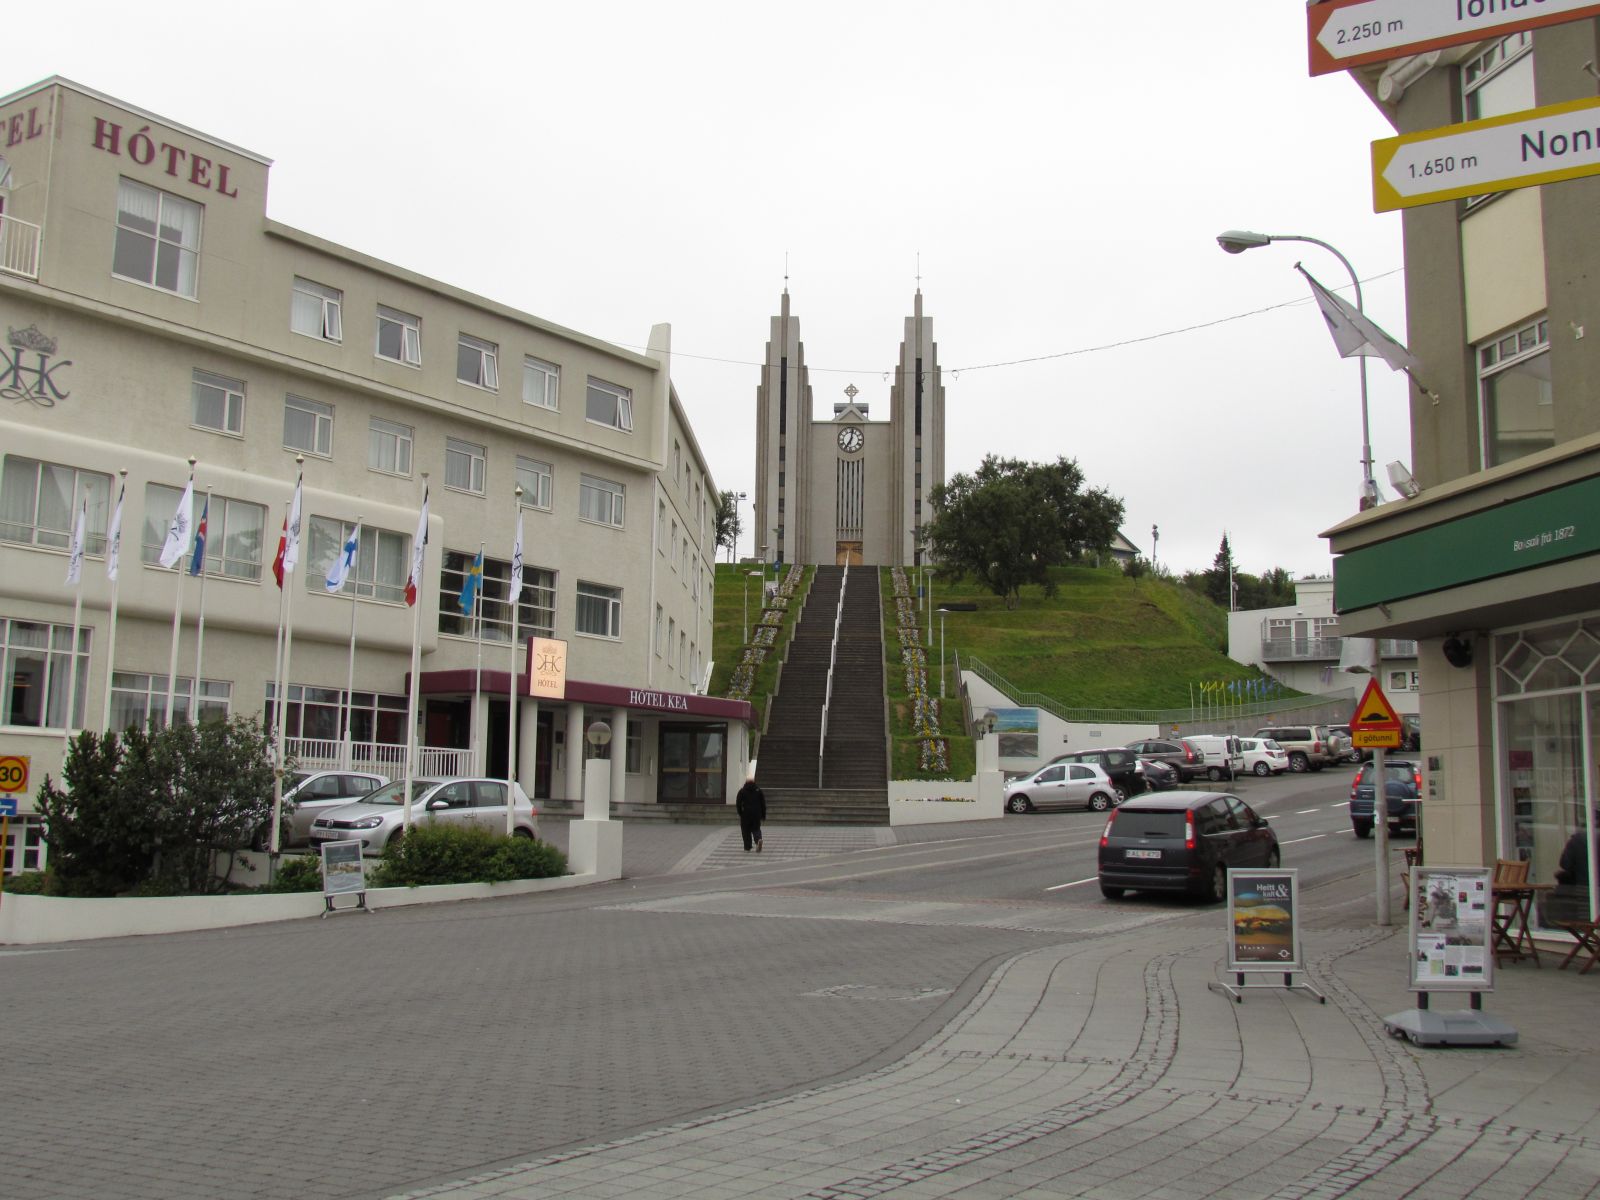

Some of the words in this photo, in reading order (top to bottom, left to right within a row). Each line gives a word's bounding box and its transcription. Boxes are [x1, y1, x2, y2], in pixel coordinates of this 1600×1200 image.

[1336, 20, 1382, 45] 2.250
[1387, 18, 1403, 33] m
[92, 116, 239, 199] HÓTEL
[1408, 156, 1454, 179] 1.650
[1461, 154, 1478, 169] m
[1521, 128, 1600, 162] Non
[1554, 525, 1575, 541] 1872
[537, 678, 559, 689] HÓTEL
[629, 689, 665, 707] HÓTEL
[668, 694, 688, 710] KEA
[0, 766, 22, 782] 30
